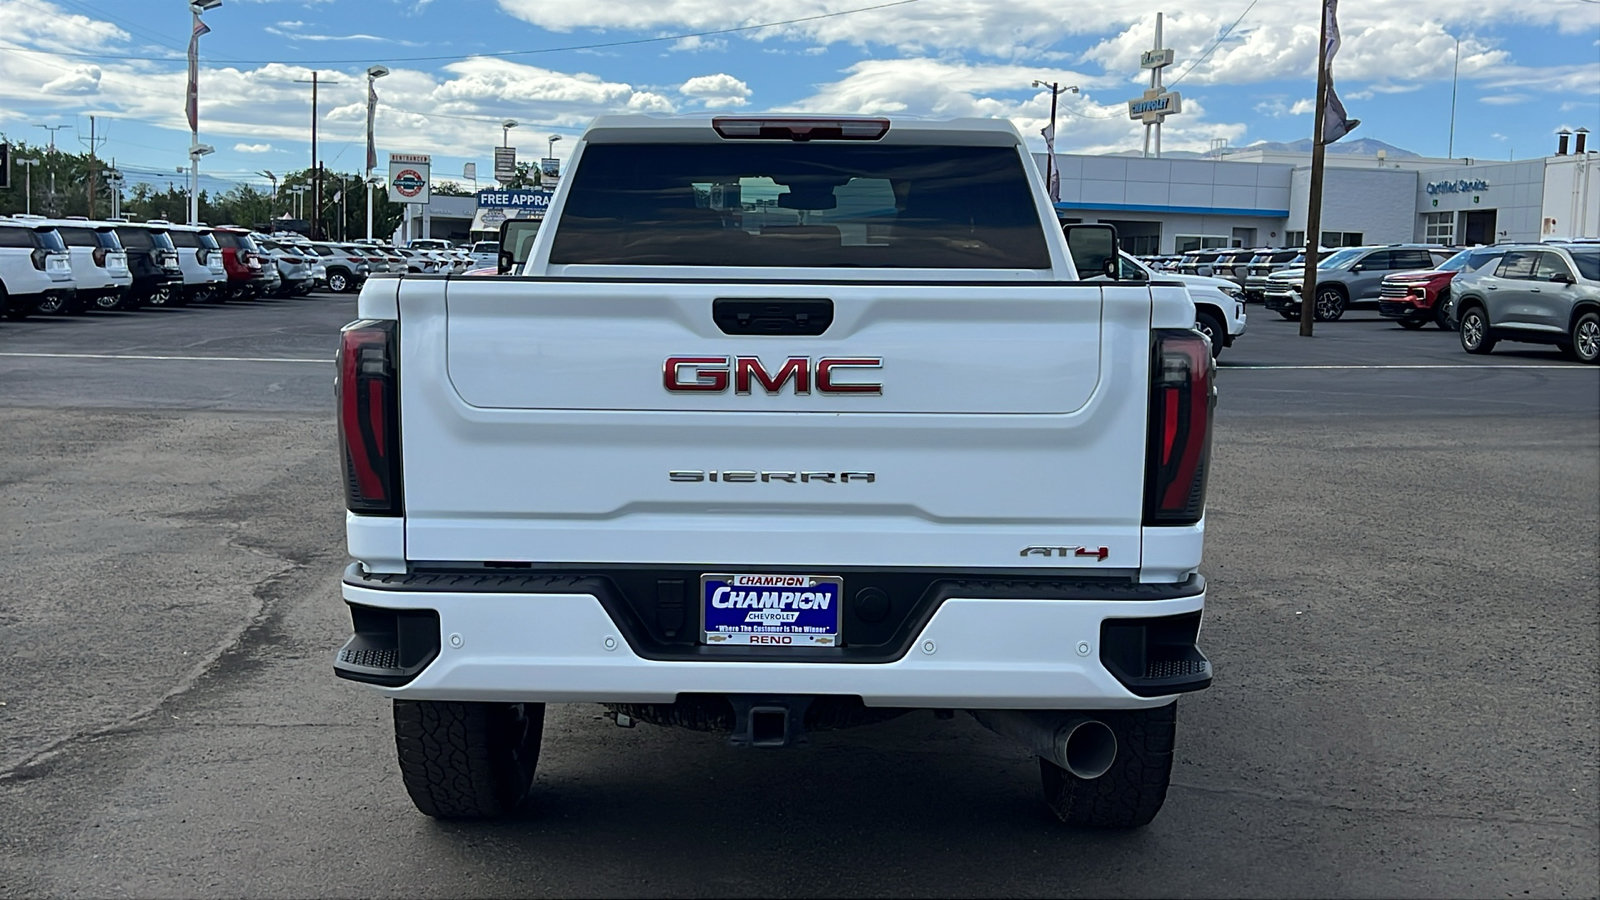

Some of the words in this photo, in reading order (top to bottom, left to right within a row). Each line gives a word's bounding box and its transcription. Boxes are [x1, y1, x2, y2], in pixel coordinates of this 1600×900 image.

[481, 193, 509, 205] FREE
[511, 194, 553, 206] APPRA
[662, 354, 884, 396] GMC
[669, 470, 876, 484] SIERRA
[1020, 545, 1109, 562] AT4
[739, 576, 804, 586] CHAMPION
[711, 586, 832, 610] CHAMPION
[748, 612, 795, 620] CHEVROLET
[753, 625, 783, 633] Customer
[750, 635, 792, 644] RENO
